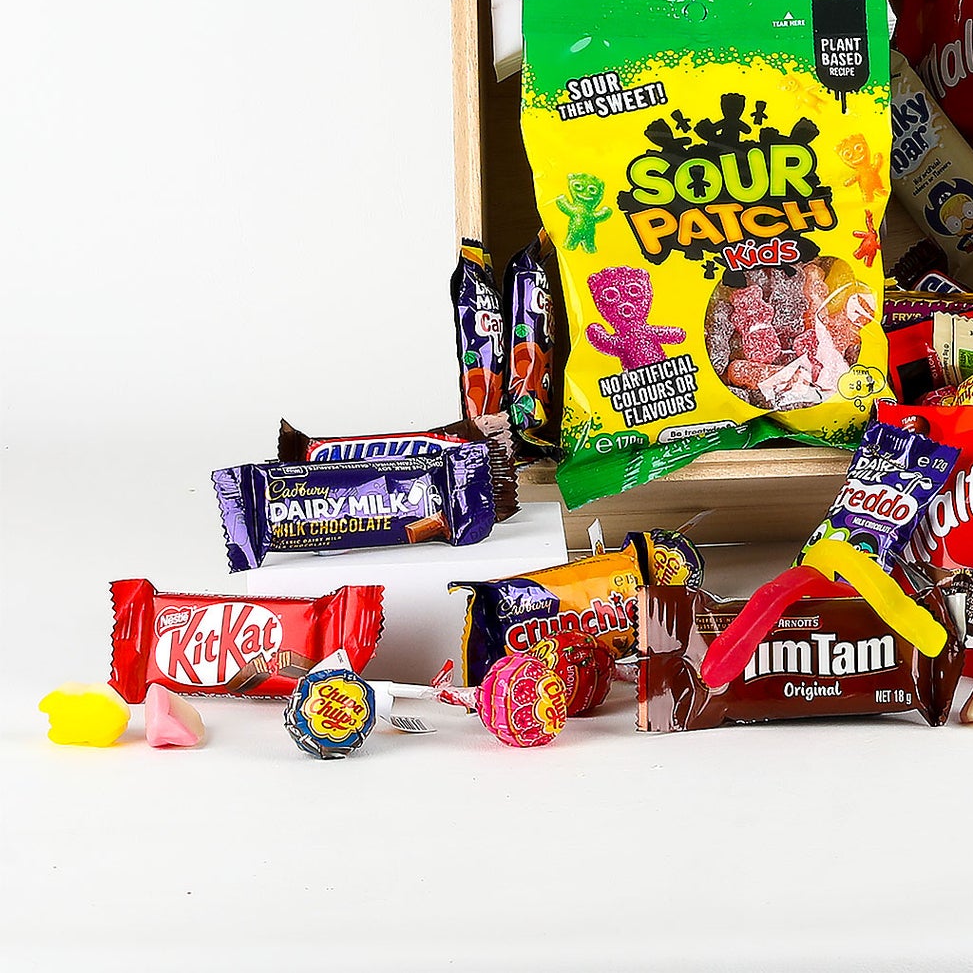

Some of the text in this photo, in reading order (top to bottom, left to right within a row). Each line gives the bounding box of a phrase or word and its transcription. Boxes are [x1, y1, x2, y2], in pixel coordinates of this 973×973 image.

[820, 37, 862, 52] PLANT
[821, 53, 863, 66] BASED
[567, 72, 621, 101] SOUR
[829, 67, 855, 76] RECIPE
[557, 83, 666, 120] THEN SWEET!
[629, 144, 814, 204] SOUR
[629, 198, 835, 256] PATCH
[723, 238, 800, 271] Kids
[600, 355, 697, 396] NO ARTIFICIAL
[612, 374, 696, 411] COLOURS OR
[624, 393, 695, 427] FLAVOURS
[932, 458, 948, 473] 12g
[265, 478, 330, 502] Cadbury
[838, 486, 910, 521] reddo
[268, 492, 414, 523] DAIRY MILK
[271, 515, 392, 539] MILK CHOCOLATE
[168, 603, 279, 684] KitKat
[317, 684, 365, 716] Chupa
[784, 680, 842, 701] Original
[875, 689, 892, 704] NET
[893, 688, 905, 703] 18
[309, 697, 357, 730] Chups
